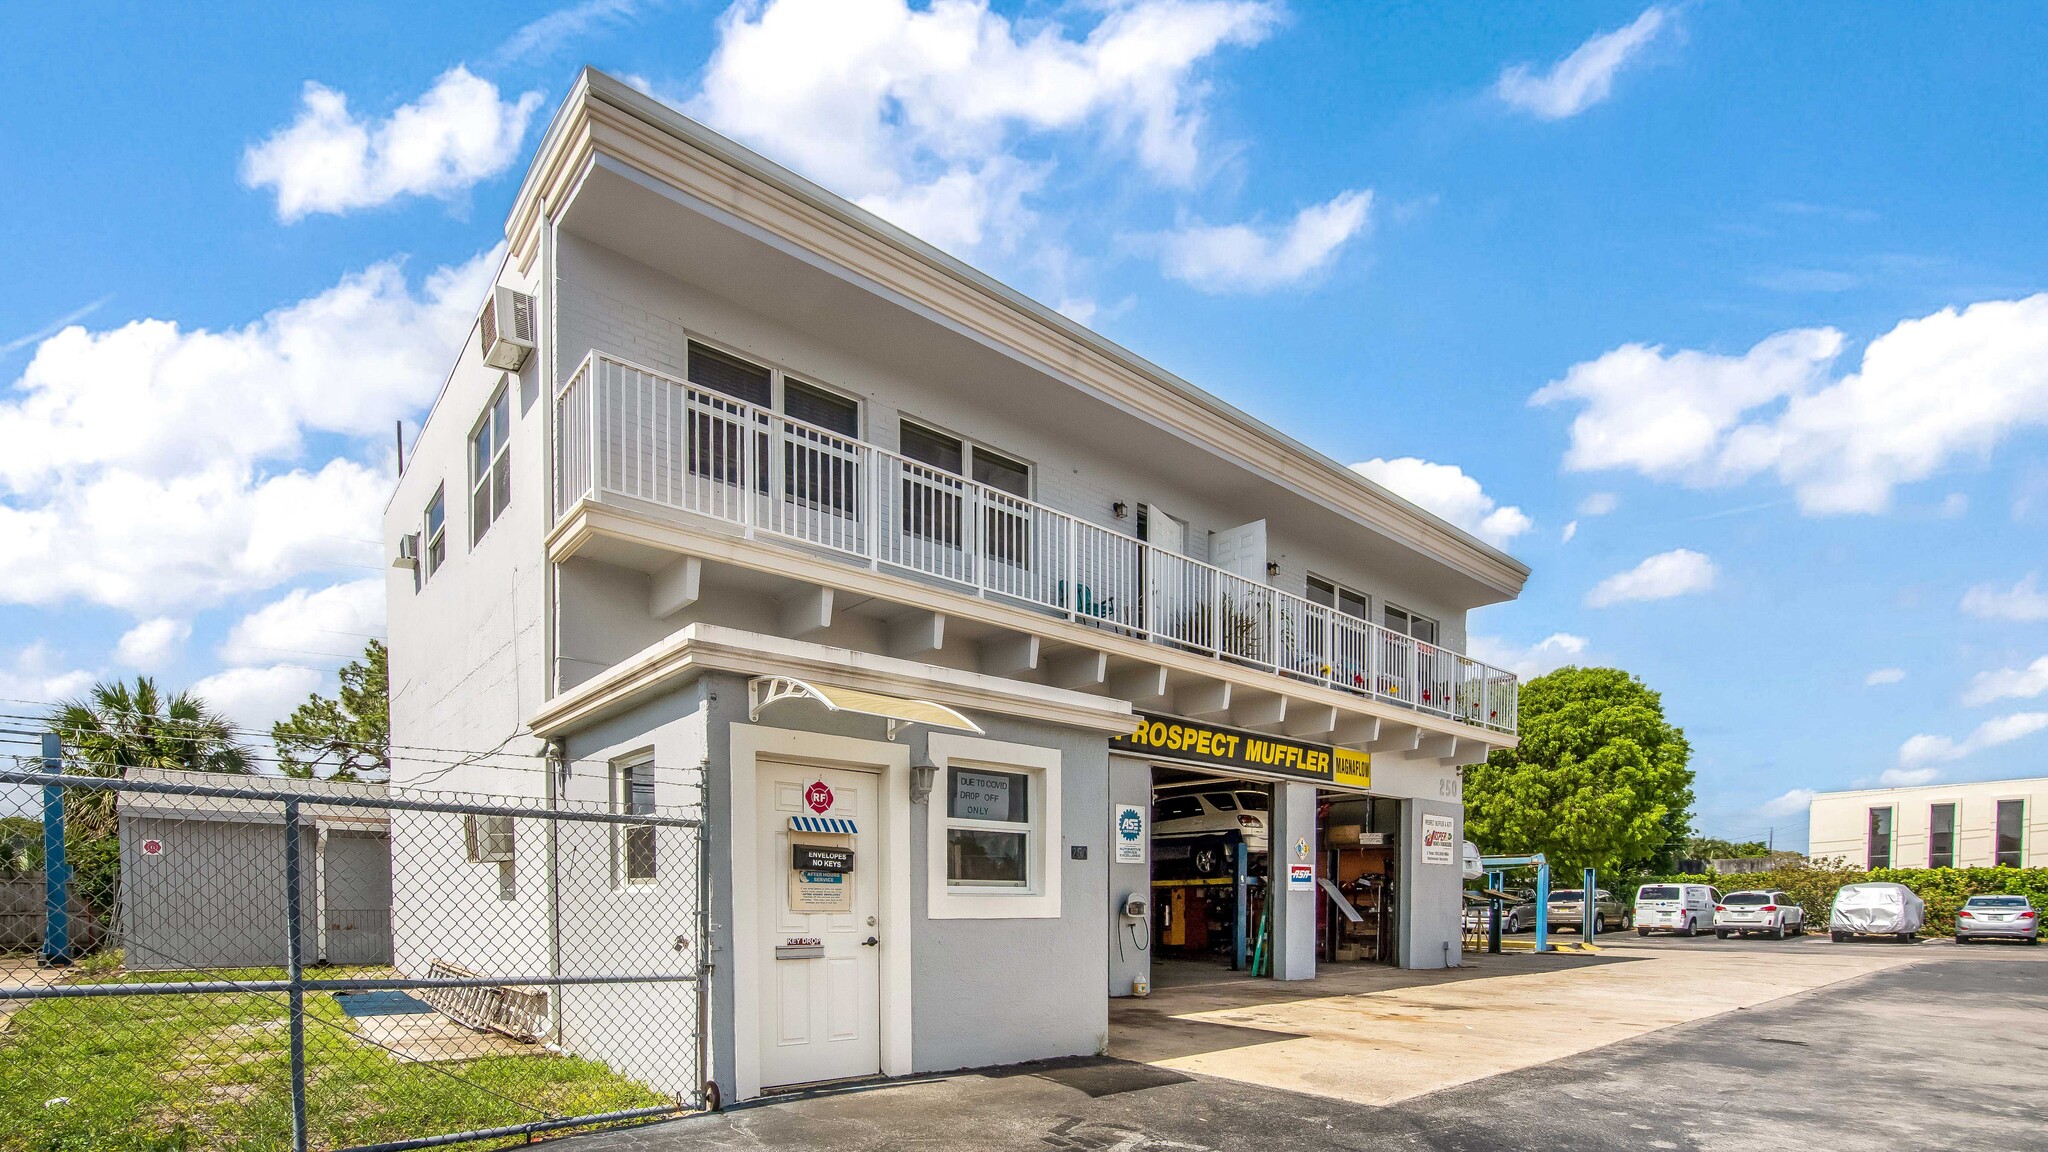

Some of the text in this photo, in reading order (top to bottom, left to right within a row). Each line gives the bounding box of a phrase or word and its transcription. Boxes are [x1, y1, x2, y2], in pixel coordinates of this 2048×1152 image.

[1115, 720, 1330, 774] ROSPECT MUFFLER
[960, 777, 1007, 790] DUE TO COVID
[1440, 778, 1457, 797] 250
[813, 793, 826, 802] RF
[960, 790, 999, 803] DROP OFF
[967, 806, 989, 815] ONLY
[1121, 818, 1138, 830] ASE
[808, 851, 847, 860] ENVELOPES
[824, 860, 842, 868] KEYS
[787, 937, 821, 945] KEY DROP
